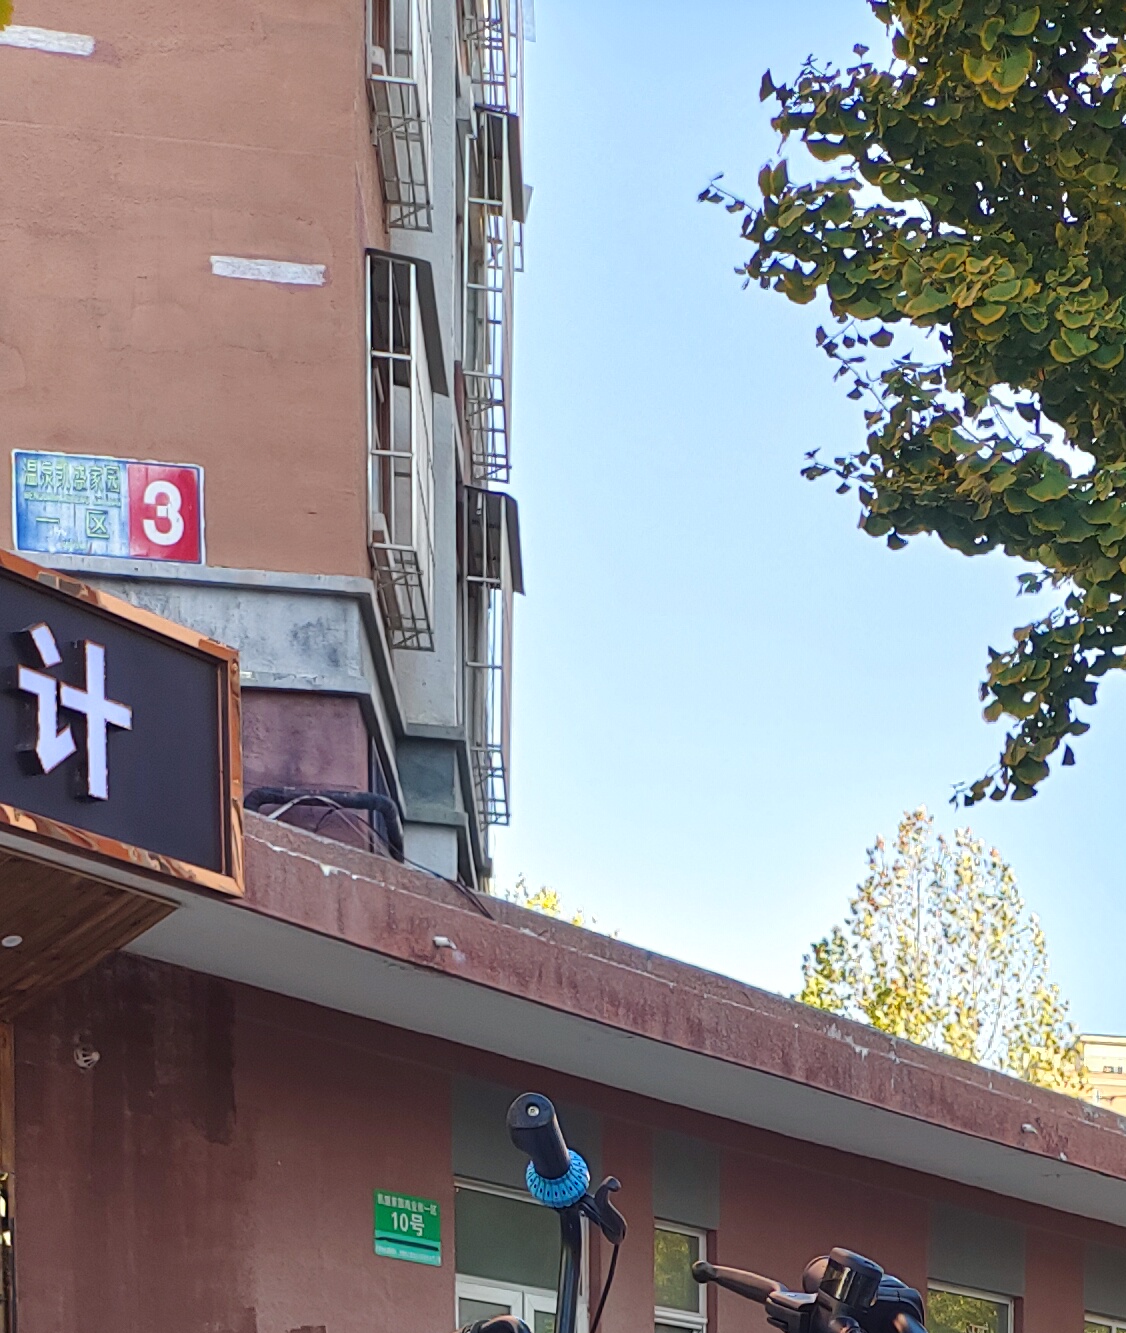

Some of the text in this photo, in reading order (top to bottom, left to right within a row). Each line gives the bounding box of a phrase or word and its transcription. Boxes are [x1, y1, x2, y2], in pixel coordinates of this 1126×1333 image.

[142, 480, 185, 546] 3
[18, 621, 132, 800] 计
[391, 1211, 425, 1237] 10号
